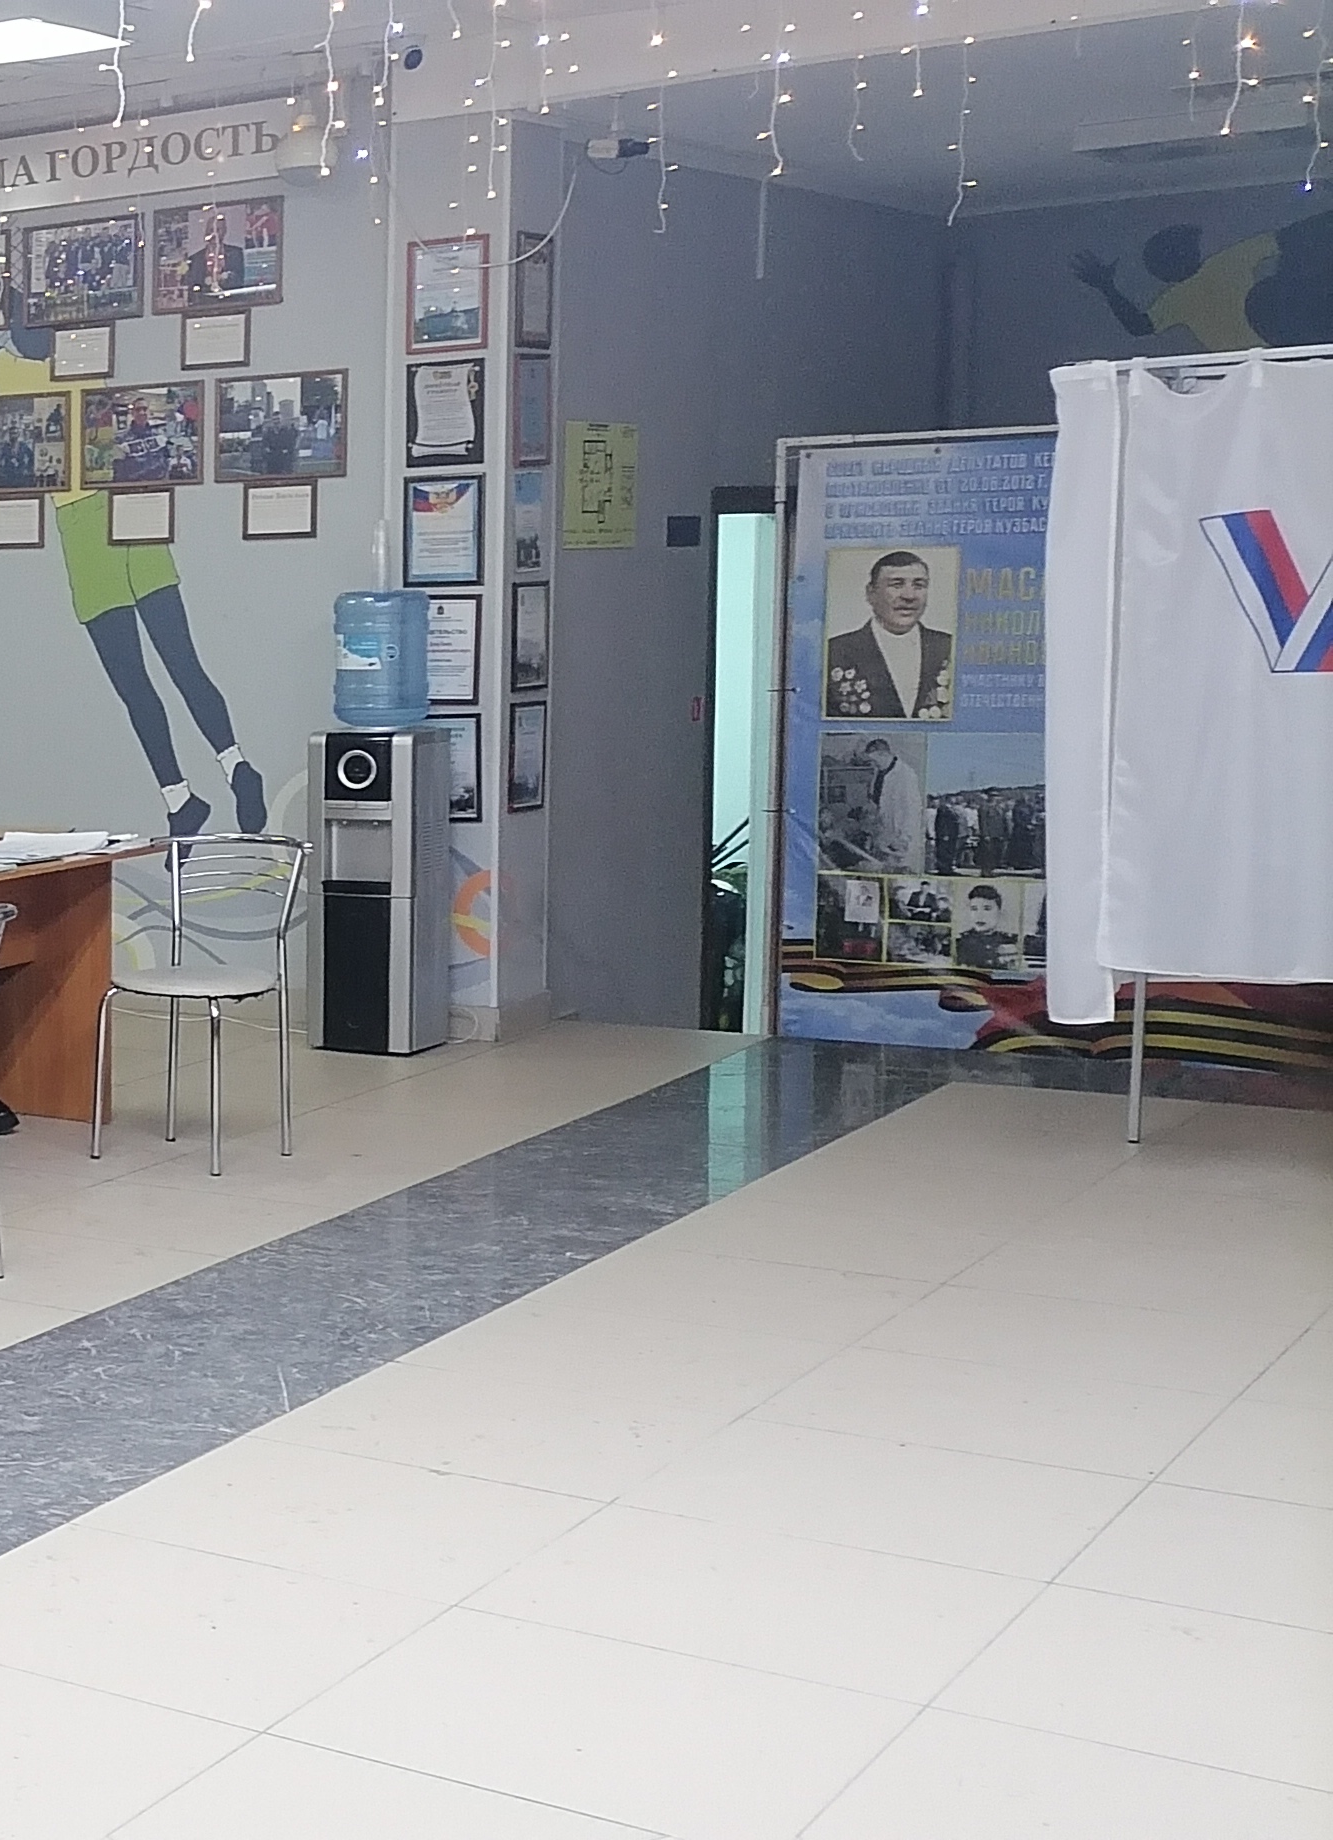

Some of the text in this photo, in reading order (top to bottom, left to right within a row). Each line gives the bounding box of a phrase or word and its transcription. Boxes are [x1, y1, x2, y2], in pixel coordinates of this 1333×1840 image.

[46, 120, 280, 183] ГОРДОСТЬ
[948, 453, 1028, 473] ДЕПУТАТОВ
[965, 567, 1046, 602] МАС
